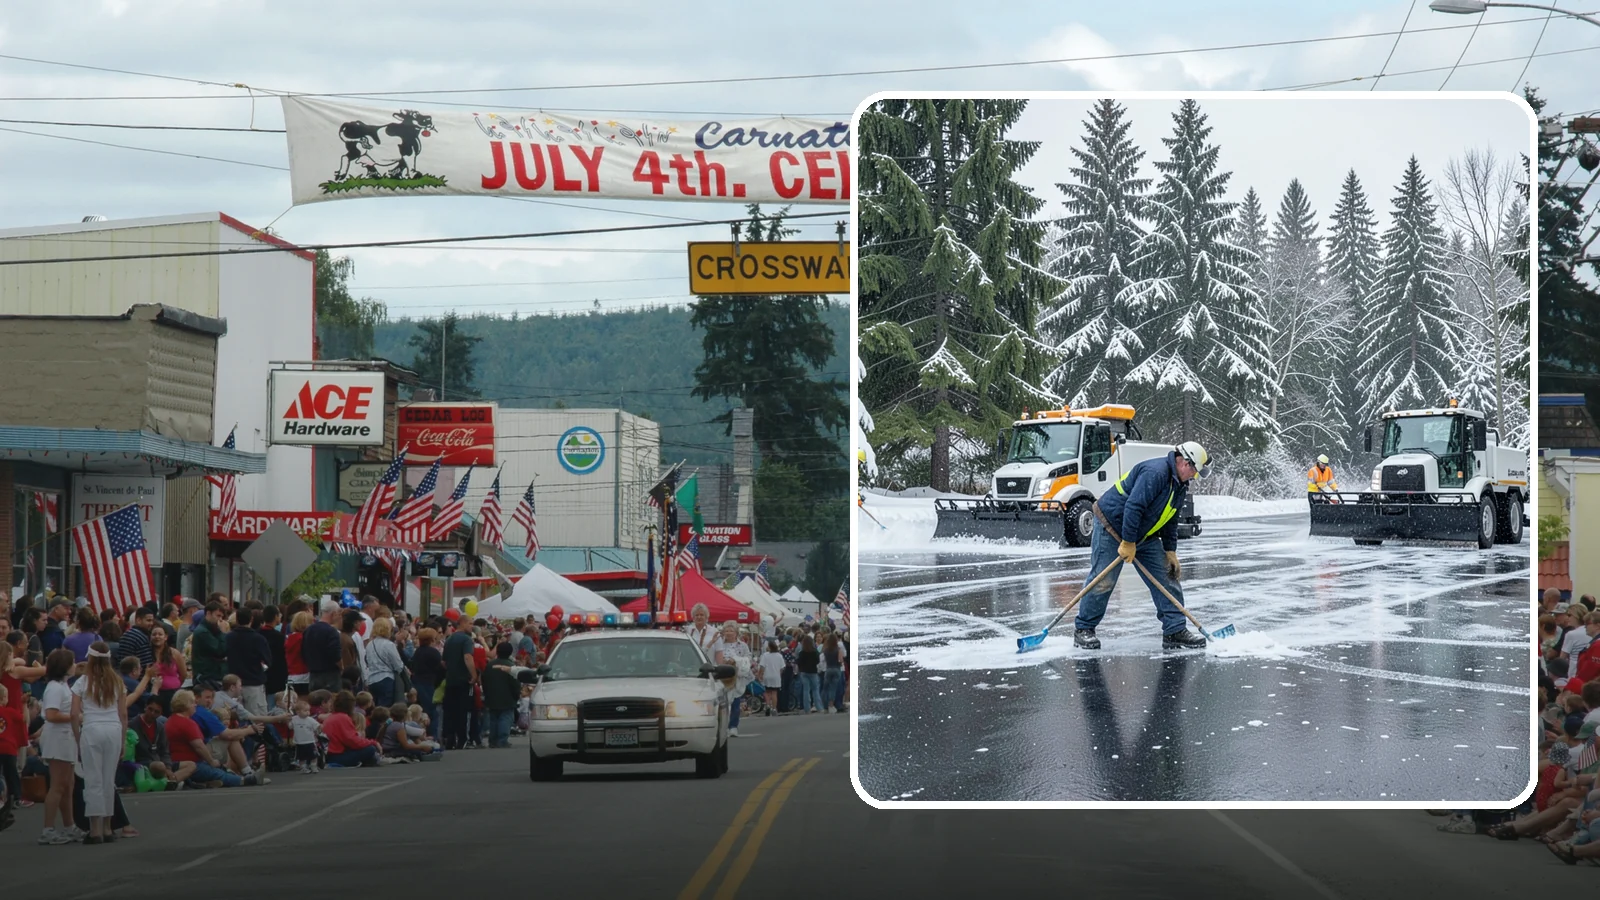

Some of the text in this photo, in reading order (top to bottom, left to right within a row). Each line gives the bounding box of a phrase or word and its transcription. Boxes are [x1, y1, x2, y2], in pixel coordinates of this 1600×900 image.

[481, 141, 605, 192] JULY
[632, 150, 746, 198] 4th.
[697, 254, 850, 279] CROSSWA
[283, 380, 373, 419] ACE
[406, 410, 485, 422] CEDAR LOG
[283, 421, 371, 436] Hardware
[353, 467, 385, 480] Simpl
[83, 485, 155, 495] St. Vincent de Paul
[212, 515, 331, 535] HARDARE
[688, 526, 741, 535] CRNATION
[699, 535, 730, 543] GLASS
